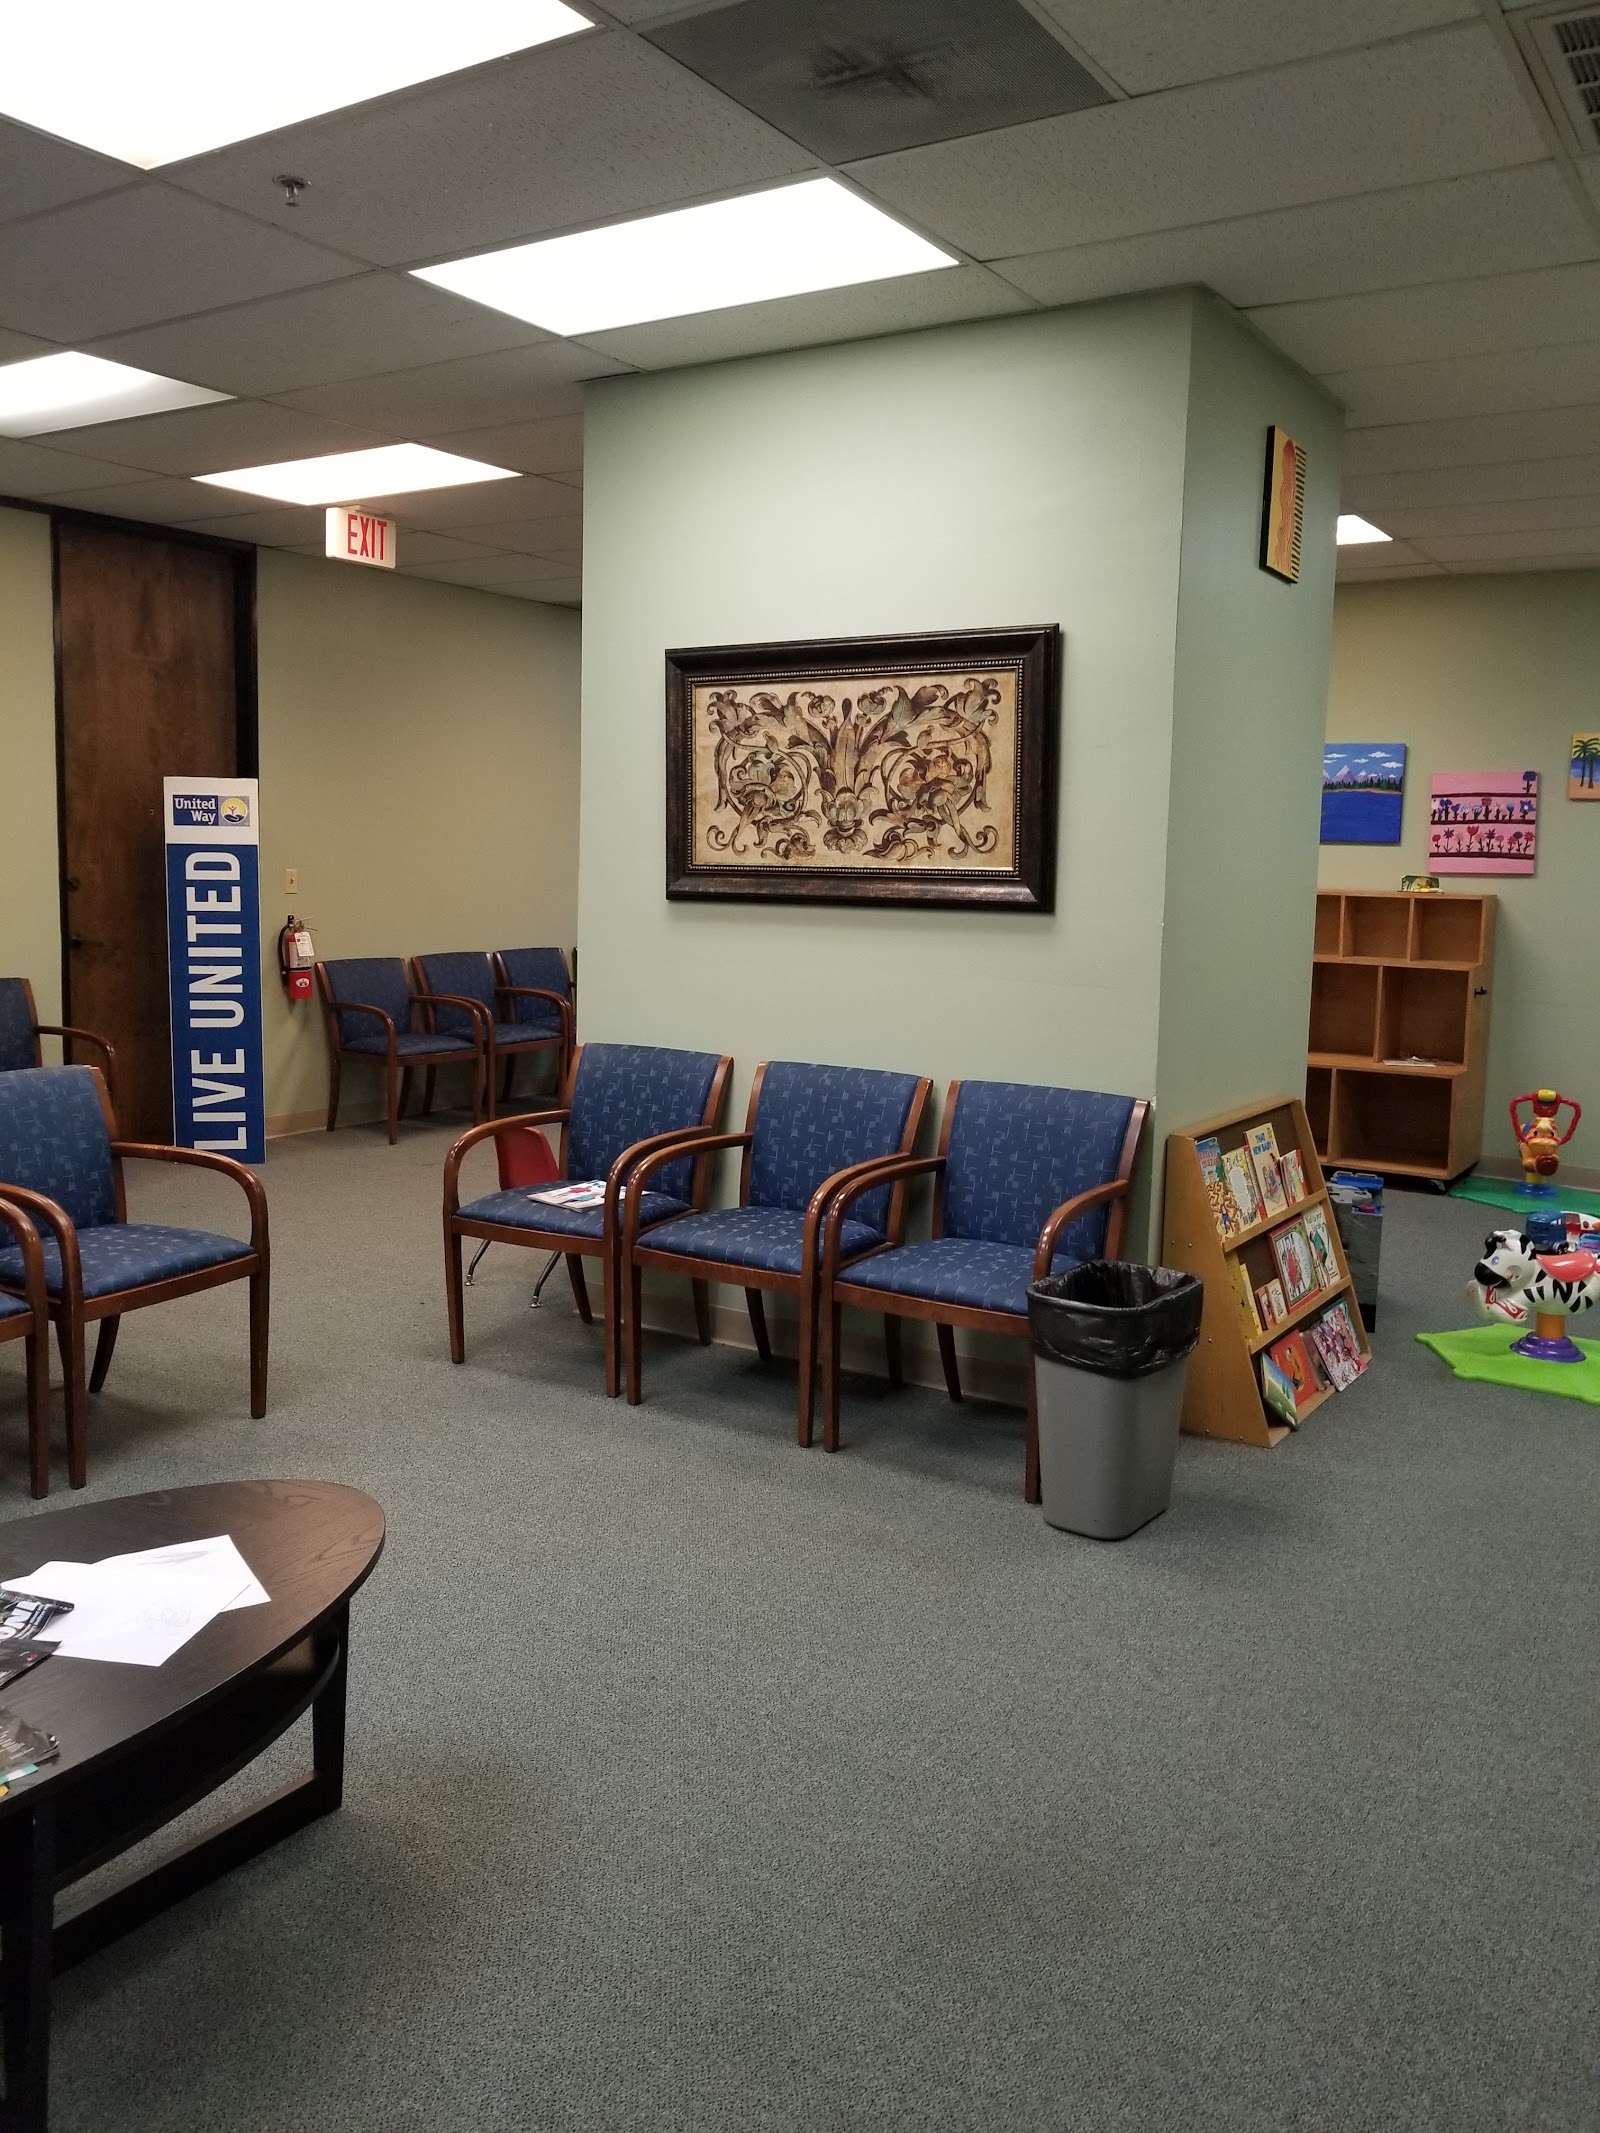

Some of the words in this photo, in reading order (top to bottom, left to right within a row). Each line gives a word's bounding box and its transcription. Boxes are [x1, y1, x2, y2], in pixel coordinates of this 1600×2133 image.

[347, 513, 387, 561] EXIT
[174, 797, 216, 810] United
[191, 810, 216, 825] Way
[185, 851, 244, 1028] UNITED
[190, 1048, 247, 1150] LIVE
